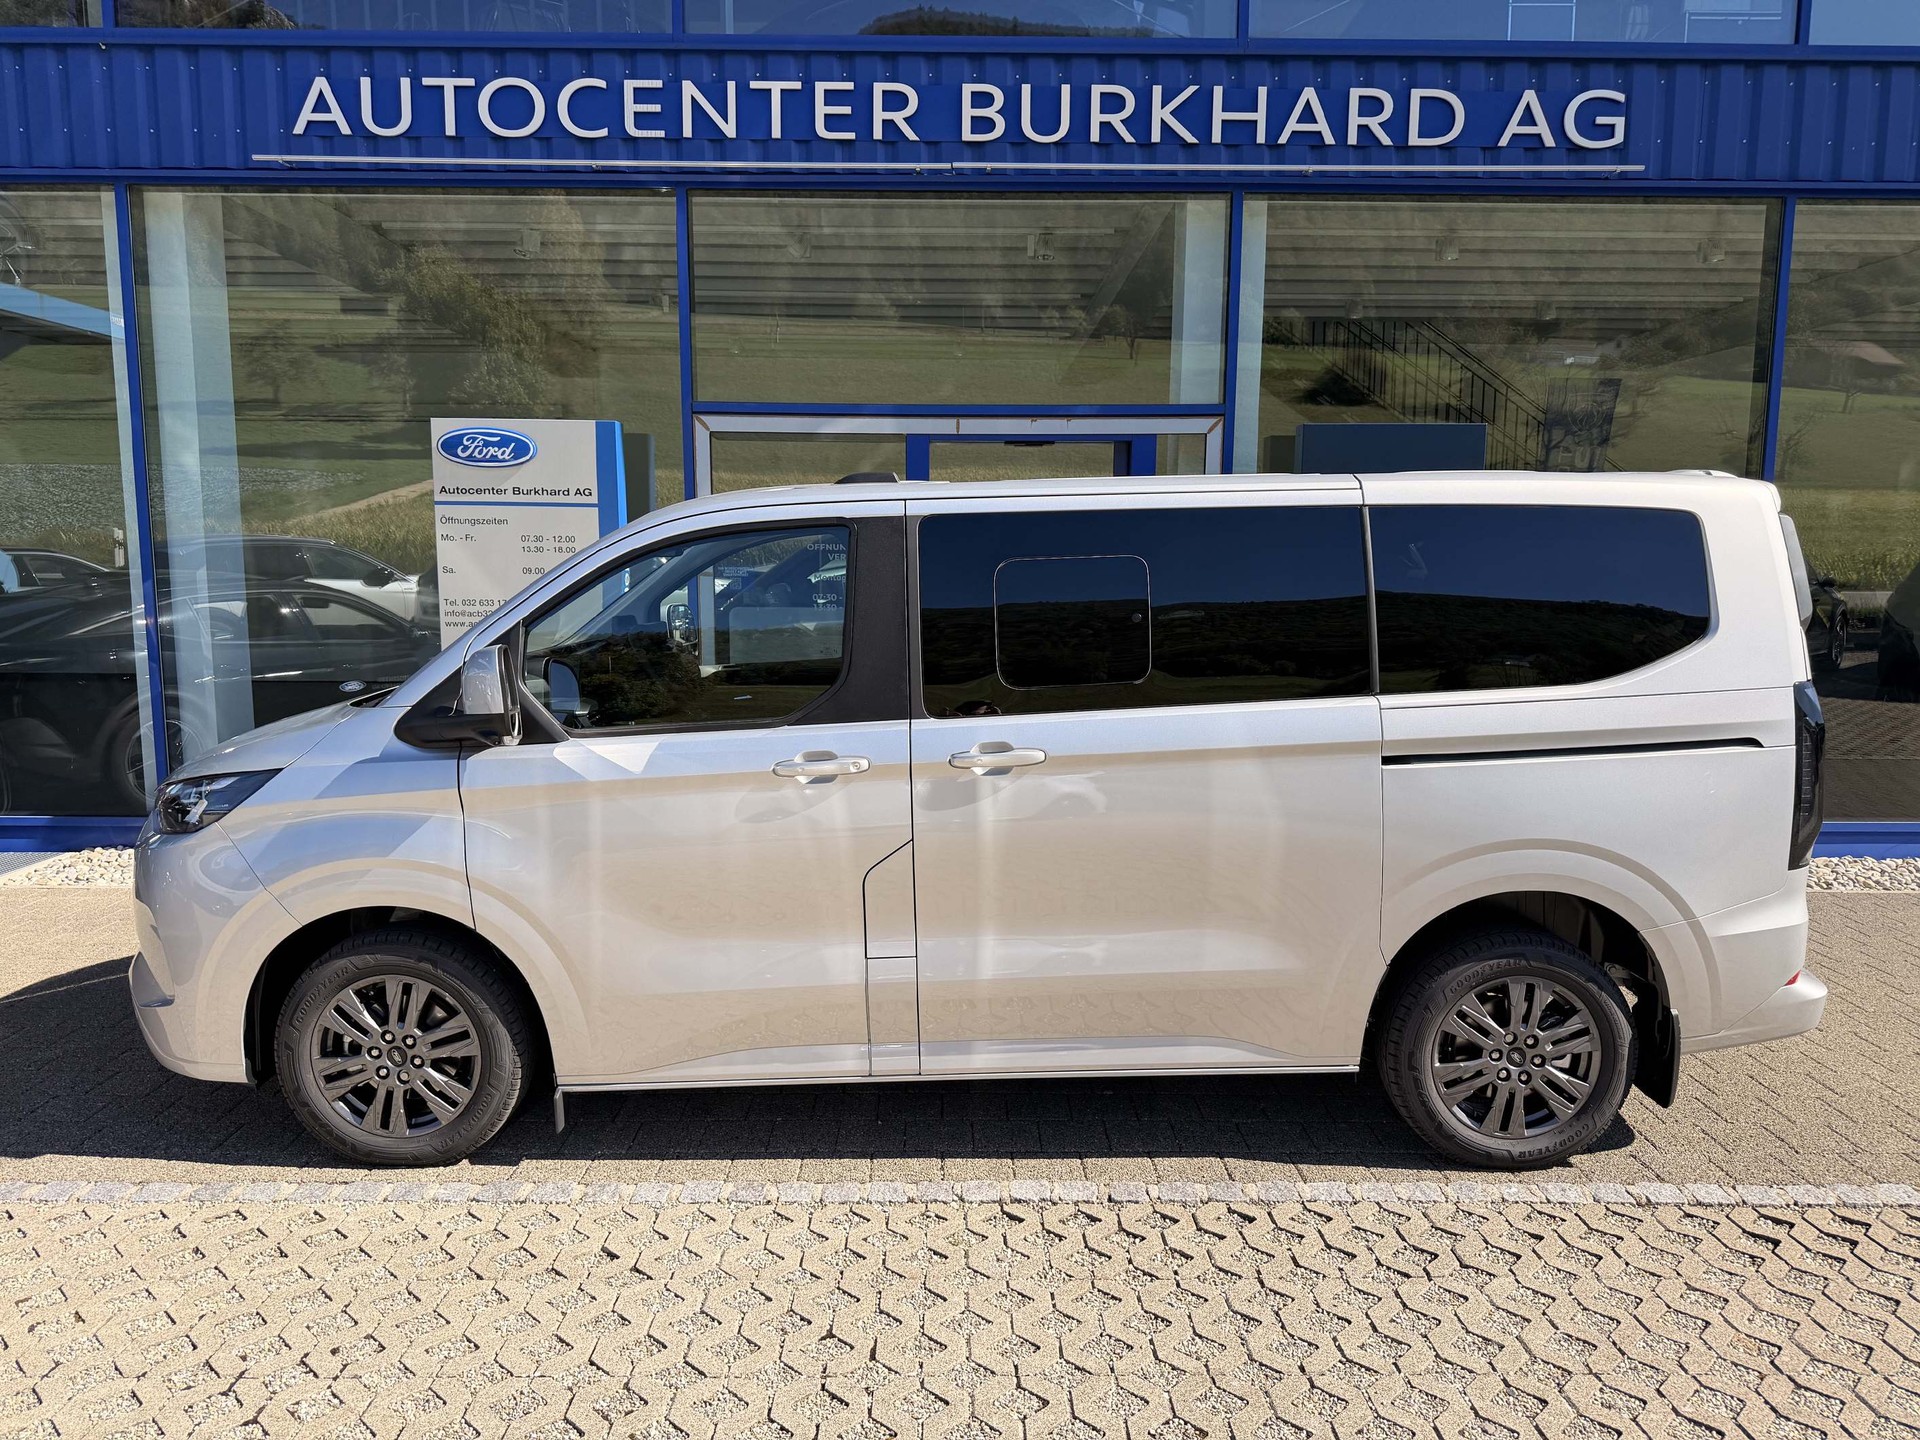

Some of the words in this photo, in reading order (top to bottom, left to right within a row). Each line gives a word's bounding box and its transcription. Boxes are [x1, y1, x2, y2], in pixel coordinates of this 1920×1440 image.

[291, 75, 921, 142] AUTOCENTER
[960, 82, 1466, 147] BURKHARD
[1496, 88, 1627, 149] AG
[457, 434, 515, 459] Ford
[439, 485, 509, 496] Autocenter
[511, 486, 570, 497] Burkhard
[574, 487, 593, 497] AG
[439, 514, 509, 527] Öffnungszeiten
[440, 533, 457, 542] Mo.
[465, 534, 477, 542] Fr.
[520, 534, 544, 543] 07.30
[552, 535, 576, 544] 12.00
[521, 545, 545, 554] 13.30
[553, 546, 577, 554] 18.00
[442, 565, 456, 574] Sa.
[522, 566, 545, 575] 09.00
[443, 598, 459, 607] Tel.
[461, 599, 477, 607] 032
[479, 599, 495, 607] 633
[1449, 958, 1522, 995] GOODYEAR
[294, 965, 350, 1026] GOODYEAR
[438, 1092, 493, 1150] GOODYEAR
[1517, 1122, 1590, 1159] GOODYEAR
